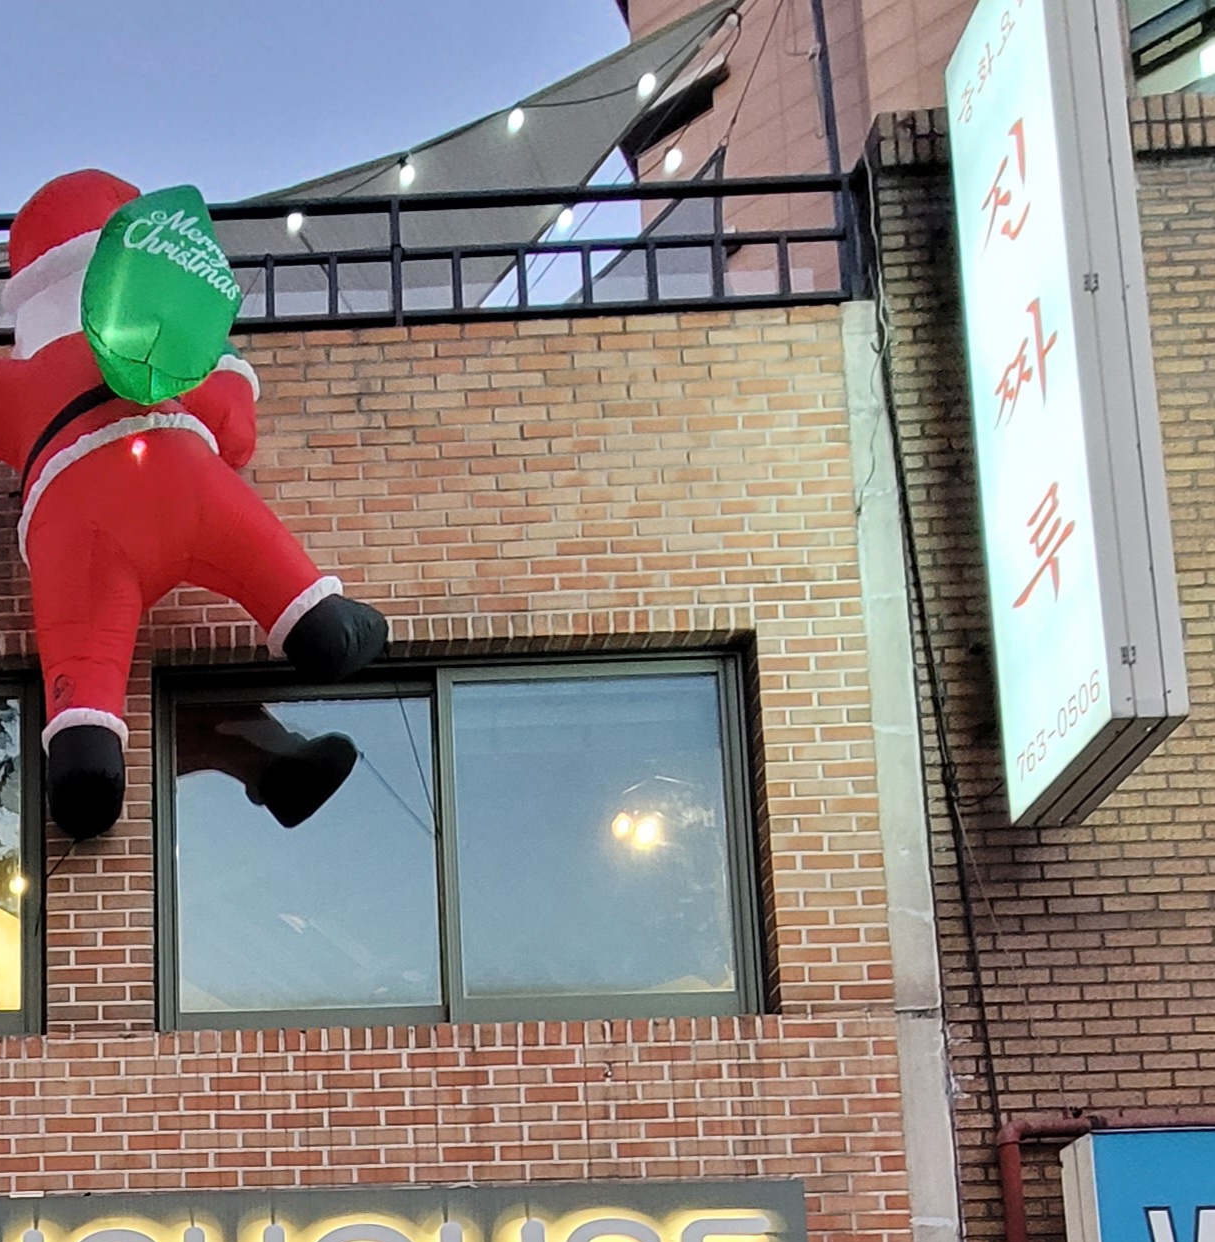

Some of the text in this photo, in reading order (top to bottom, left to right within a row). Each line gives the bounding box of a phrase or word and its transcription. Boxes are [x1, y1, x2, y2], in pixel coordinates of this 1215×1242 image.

[958, 0, 1023, 123] 중화요
[123, 218, 240, 300] Christmas
[150, 209, 235, 278] Merry
[1016, 669, 1101, 784] 763-0506
